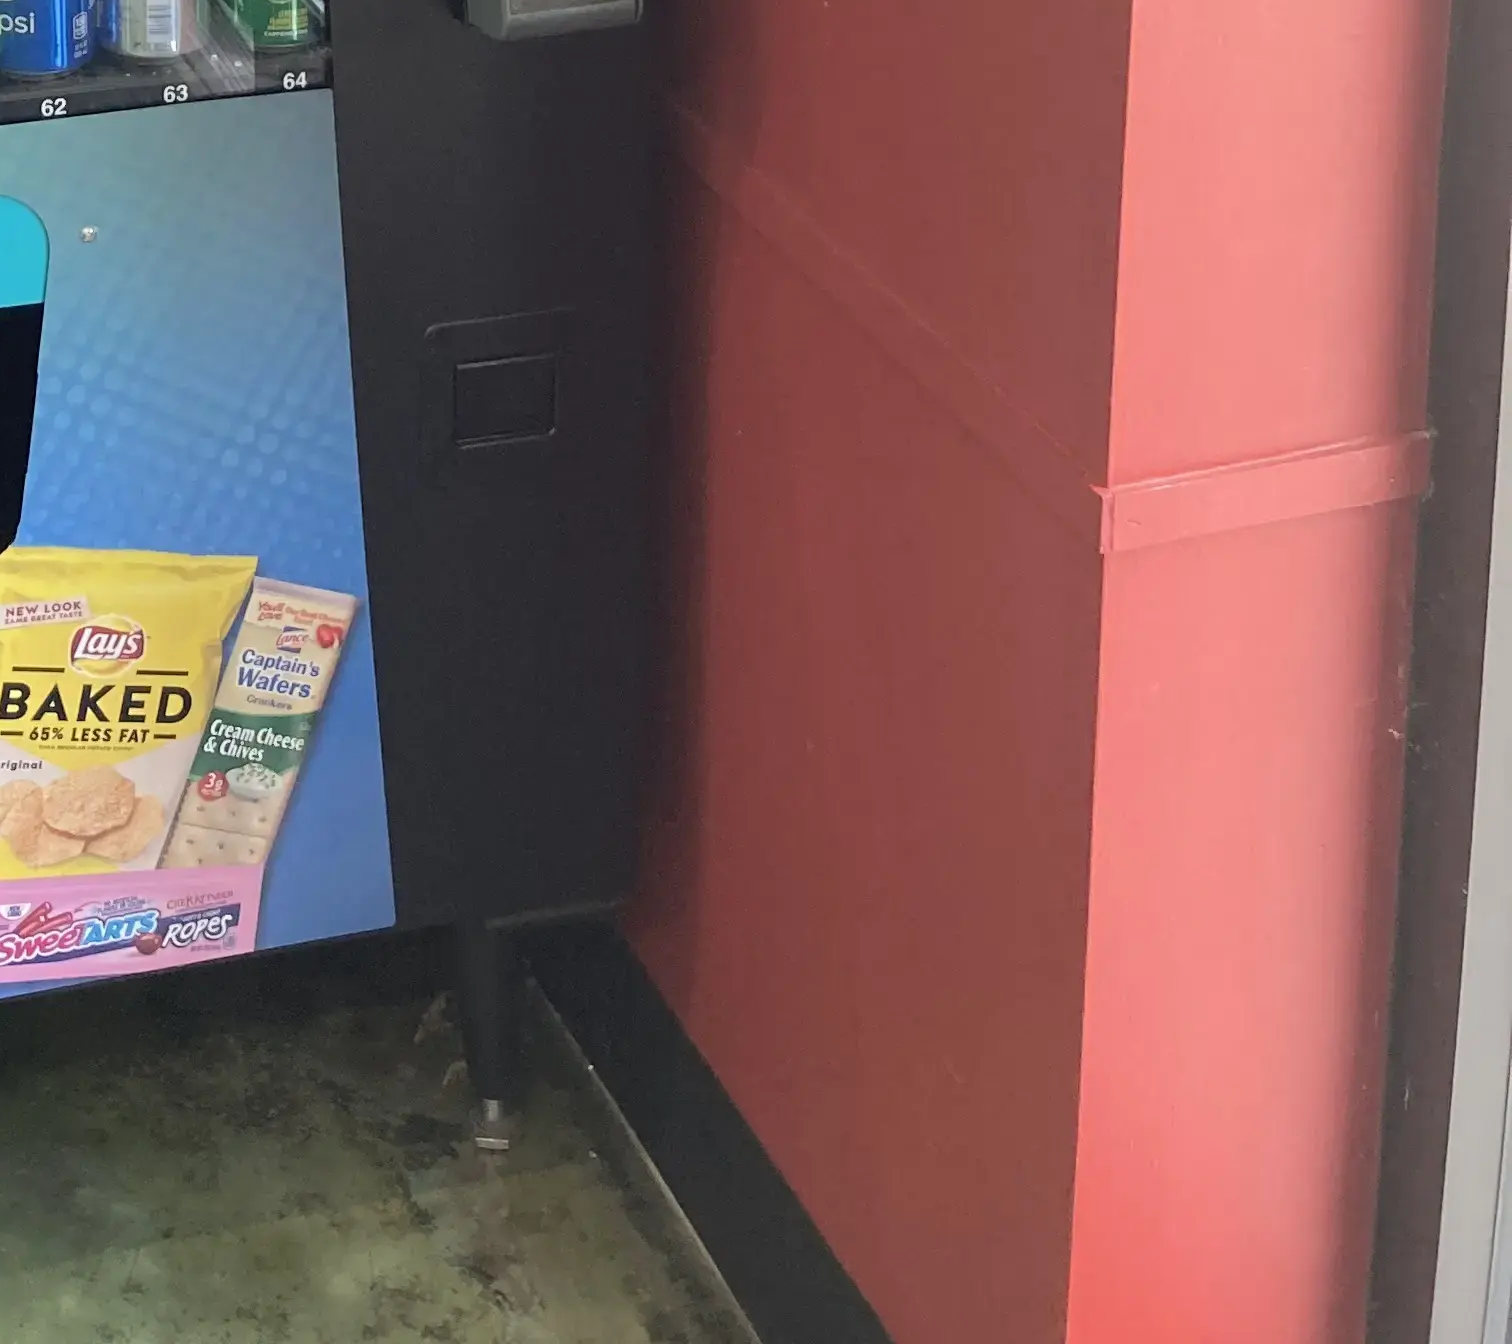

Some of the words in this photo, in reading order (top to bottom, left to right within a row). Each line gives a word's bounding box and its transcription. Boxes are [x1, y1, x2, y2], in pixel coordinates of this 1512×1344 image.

[283, 71, 308, 90] 64
[163, 84, 189, 103] 63
[41, 97, 67, 117] 62
[5, 604, 39, 618] NEW
[44, 600, 82, 614] LOOK
[73, 626, 142, 660] Lay's
[241, 648, 321, 678] Captain's
[237, 666, 313, 699] Wafers
[29, 727, 64, 742] 65%
[70, 727, 113, 743] LESS
[118, 729, 150, 744] FAT
[210, 718, 255, 743] Cream
[257, 727, 305, 751] Cheese
[203, 736, 217, 754] &
[219, 739, 265, 762] Chives
